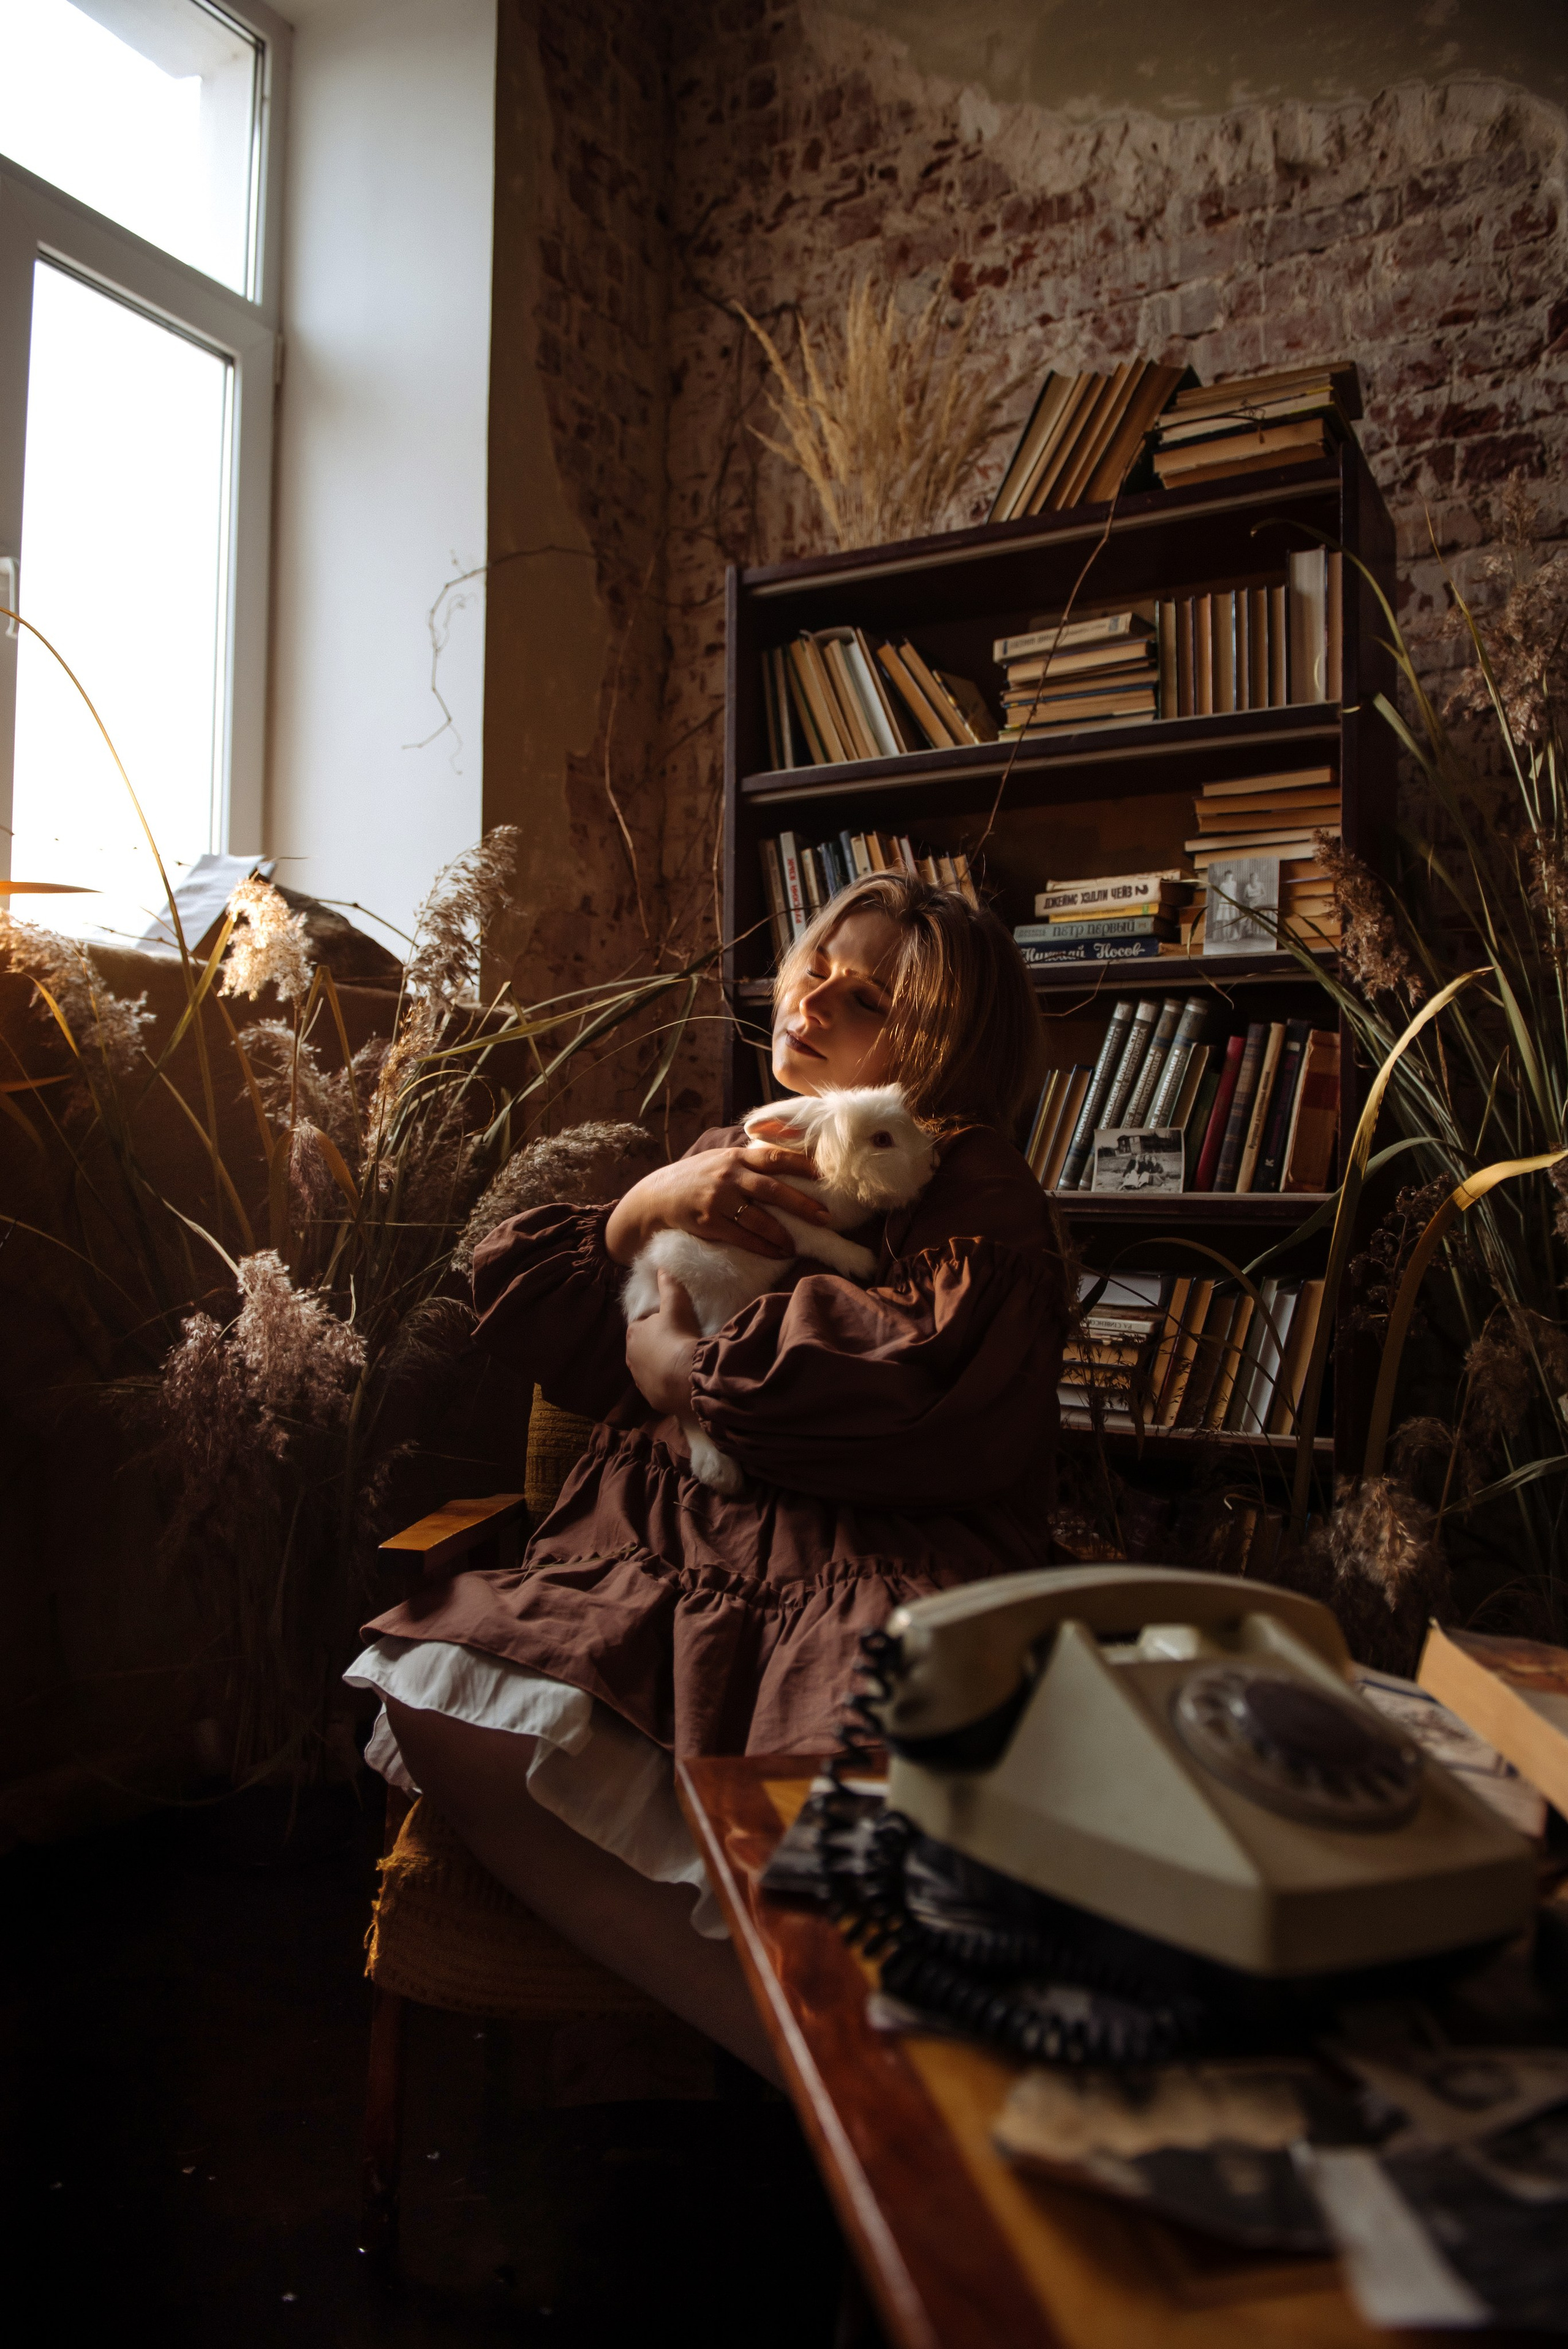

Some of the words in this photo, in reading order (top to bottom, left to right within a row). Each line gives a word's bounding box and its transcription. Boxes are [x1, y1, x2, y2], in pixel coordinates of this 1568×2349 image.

[786, 858, 796, 881] ЯЗЫК
[1043, 892, 1078, 909] ДЖЕЙМС
[1080, 889, 1108, 904] ХЭДЛИ
[1111, 885, 1132, 899] ЧЕЙЗ
[1093, 942, 1145, 959] Носов
[1101, 1081, 1121, 1130] ОМАТИЗАЦИЯ
